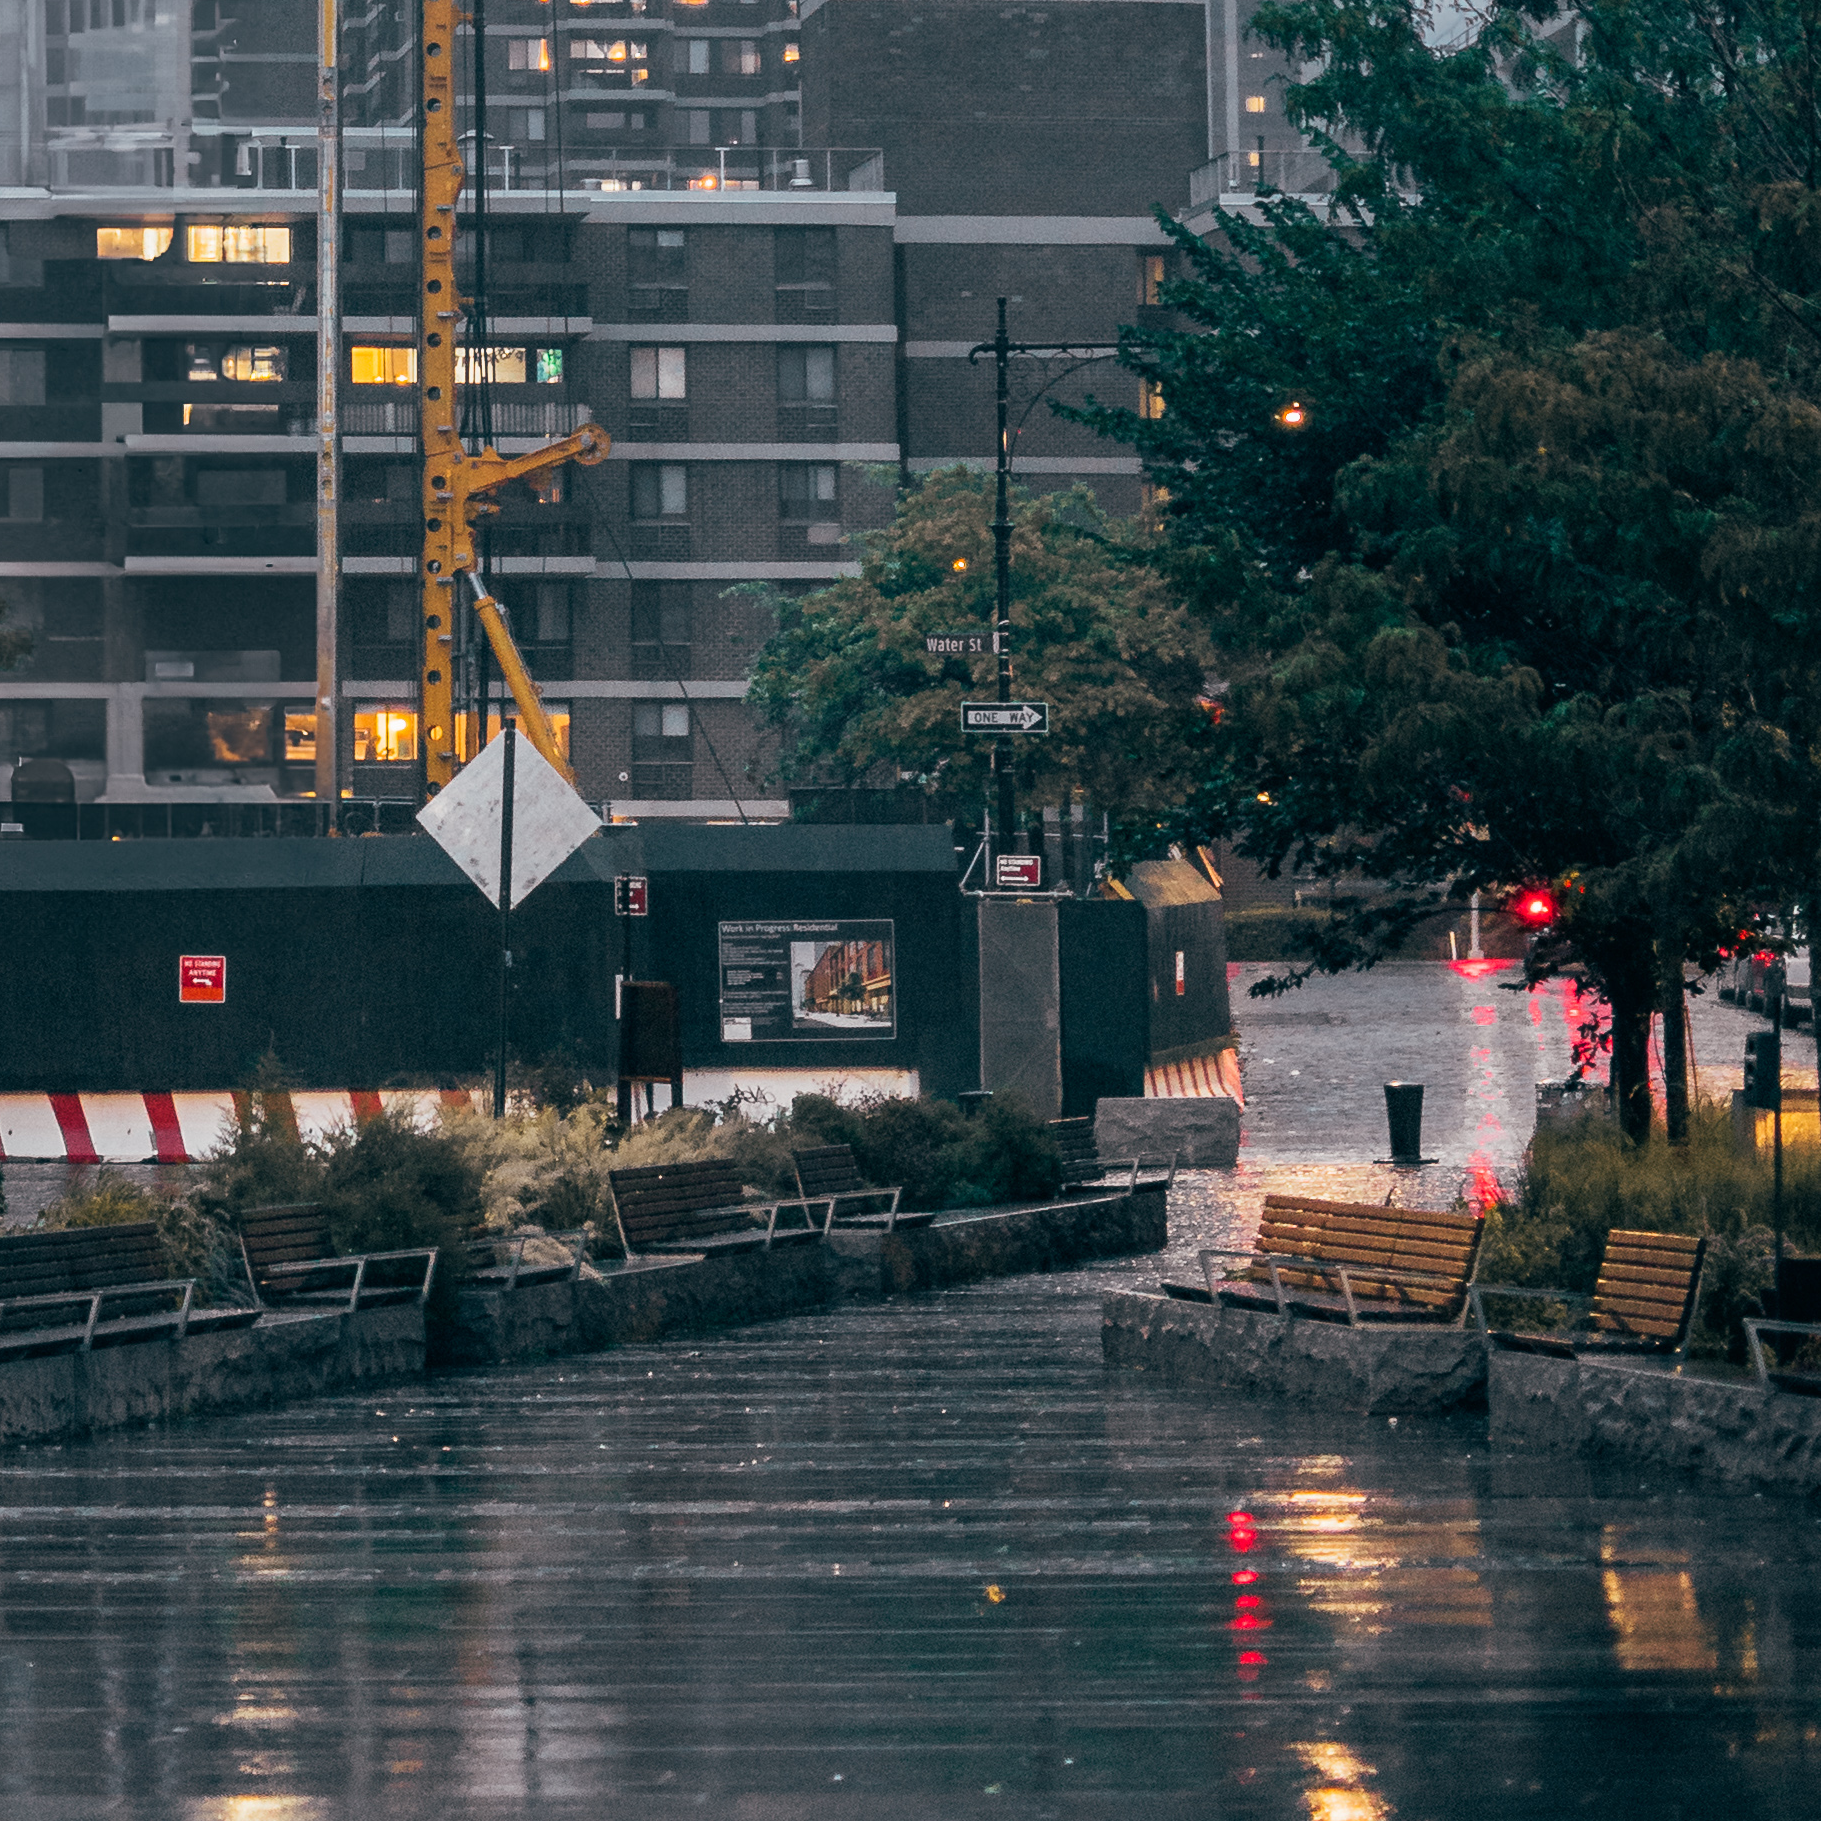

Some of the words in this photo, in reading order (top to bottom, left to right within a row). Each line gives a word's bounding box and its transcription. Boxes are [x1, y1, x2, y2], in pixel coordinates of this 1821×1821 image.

[927, 638, 964, 652] Water
[969, 638, 982, 652] St
[974, 712, 998, 723] ONE
[1010, 712, 1034, 723] WAY
[721, 925, 743, 933] Work
[793, 923, 838, 932] Residential
